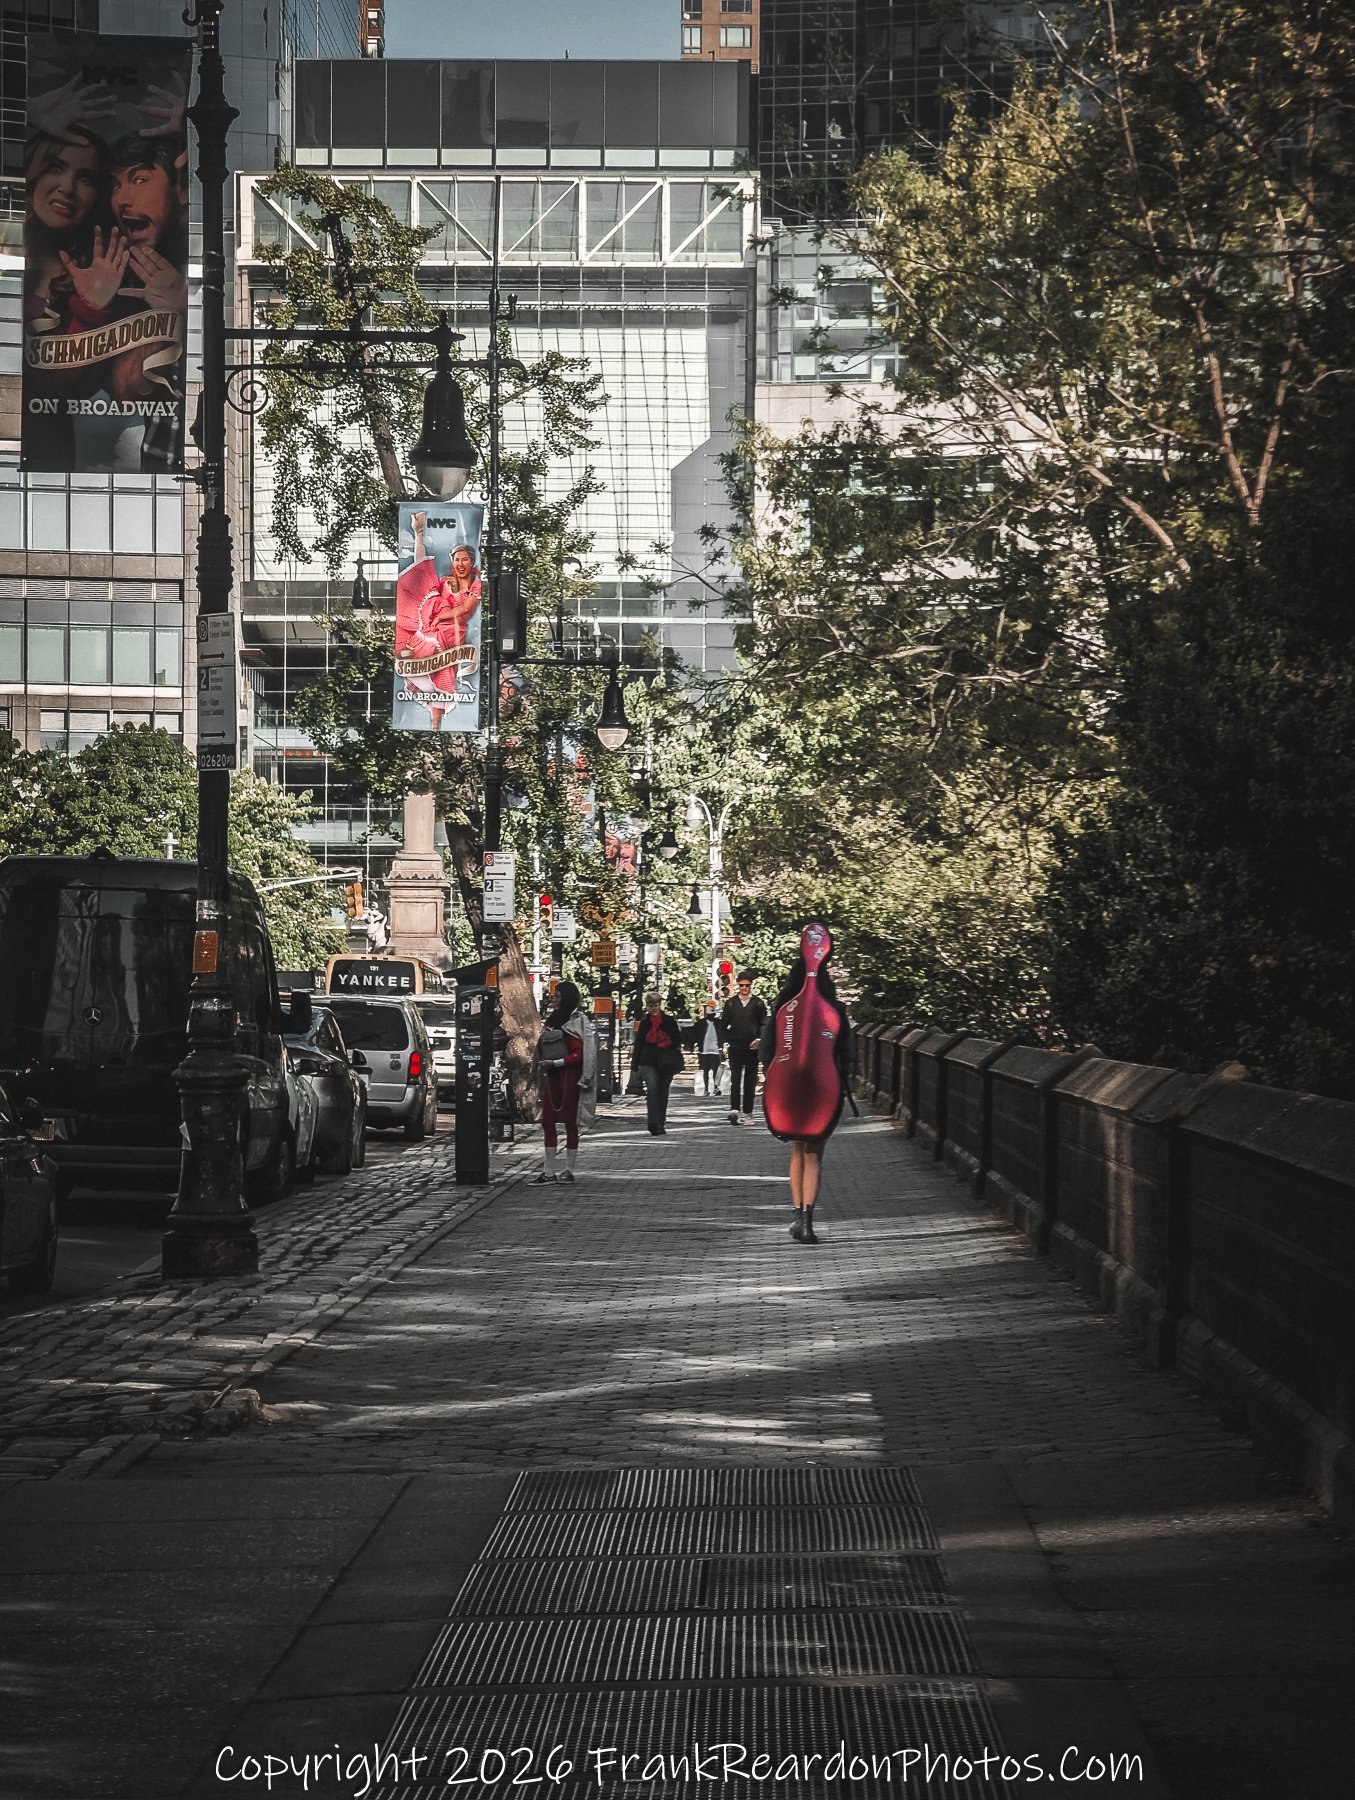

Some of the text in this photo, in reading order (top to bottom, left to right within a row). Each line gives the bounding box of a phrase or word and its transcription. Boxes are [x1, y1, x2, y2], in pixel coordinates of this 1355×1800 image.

[29, 312, 178, 366] SCHMIGADOON!
[29, 398, 179, 417] ON BROADWAY
[427, 518, 457, 529] NYC
[397, 646, 476, 675] SCHMIGADOON!
[200, 669, 207, 689] 2
[397, 691, 476, 703] ON BROADWAY
[486, 880, 492, 892] 2
[338, 974, 410, 988] YANKEE
